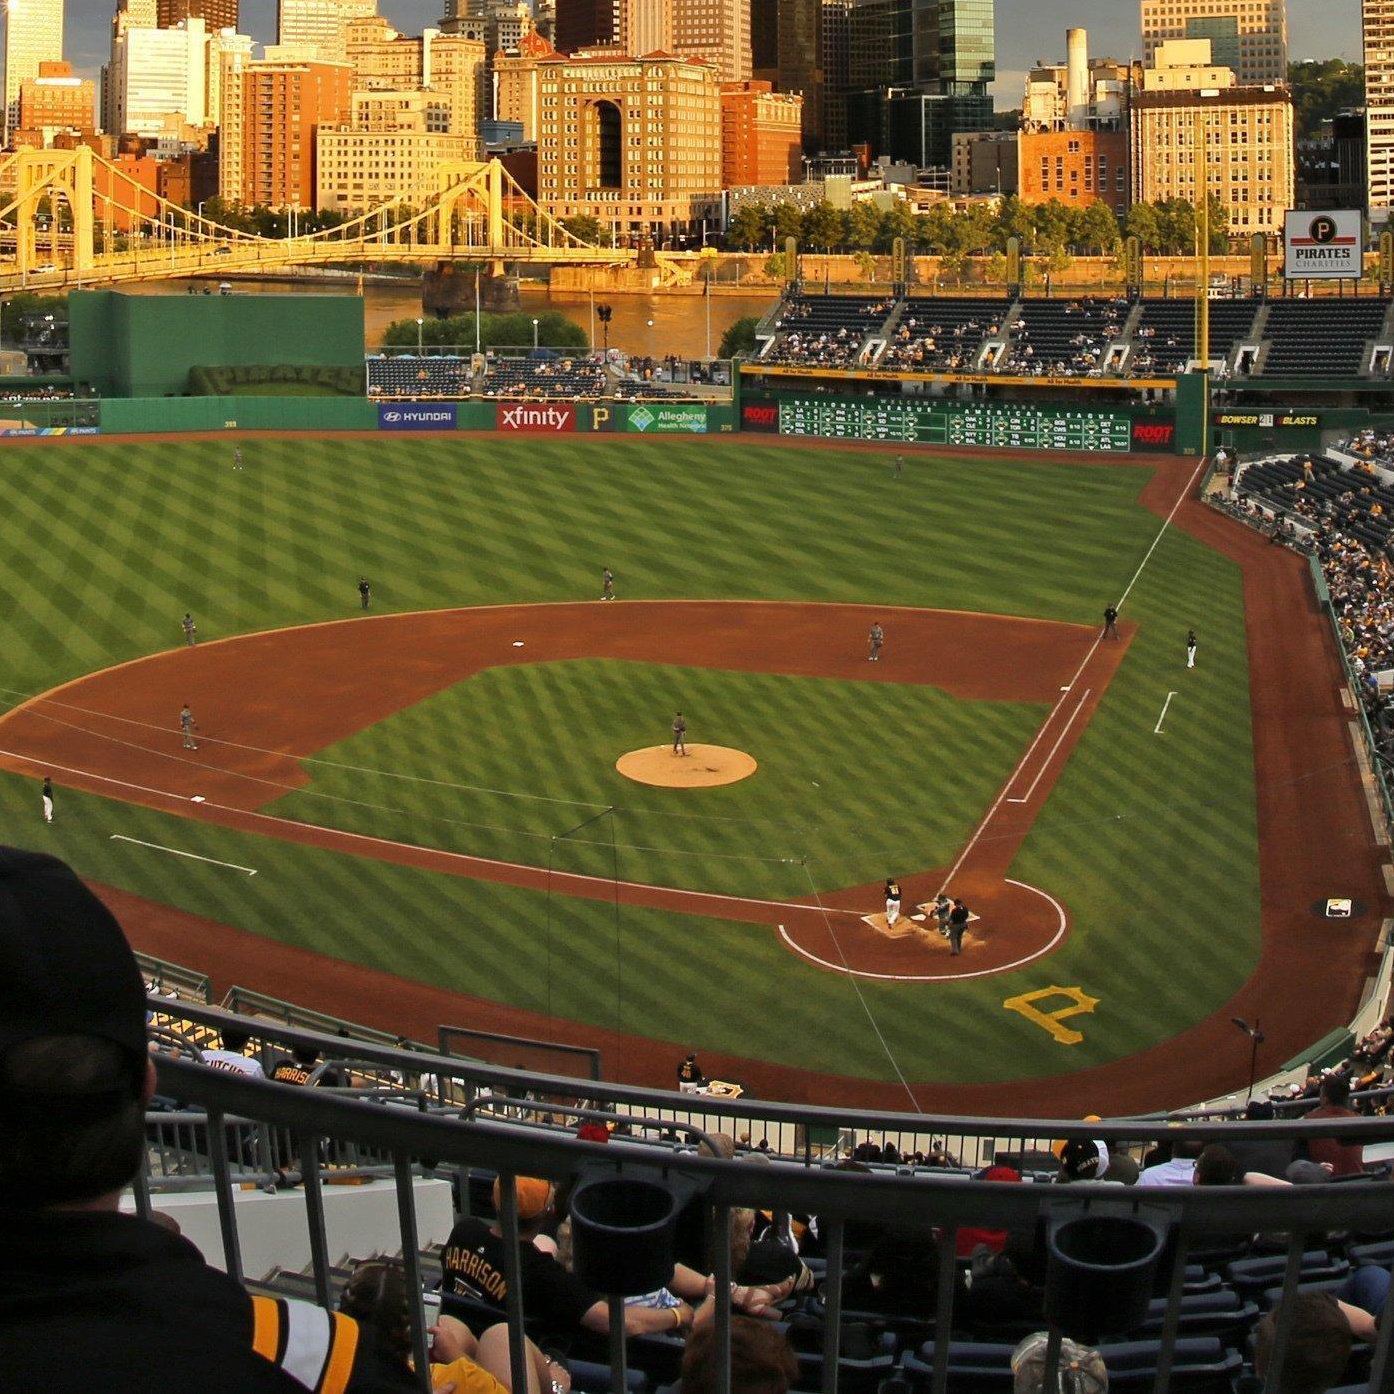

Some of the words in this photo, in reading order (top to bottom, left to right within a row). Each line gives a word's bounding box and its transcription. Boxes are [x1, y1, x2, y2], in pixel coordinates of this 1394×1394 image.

[1318, 222, 1330, 238] P
[1296, 248, 1351, 259] PIRATES
[1295, 260, 1351, 268] CHARITIES
[795, 400, 865, 409] NATIONAL
[878, 405, 931, 413] LEAGUE
[502, 407, 569, 429] xfinity
[593, 408, 609, 429] P
[658, 411, 706, 421] Allegheny
[744, 407, 777, 420] ROOT
[964, 409, 1043, 417] AMERICAN
[1056, 412, 1114, 420] LEAGUE
[1221, 416, 1258, 424] BOWSER
[1282, 417, 1317, 425] BLASTS
[1133, 426, 1173, 438] ROOT
[1003, 985, 1101, 1045] P
[445, 1245, 507, 1300] HARRISON
